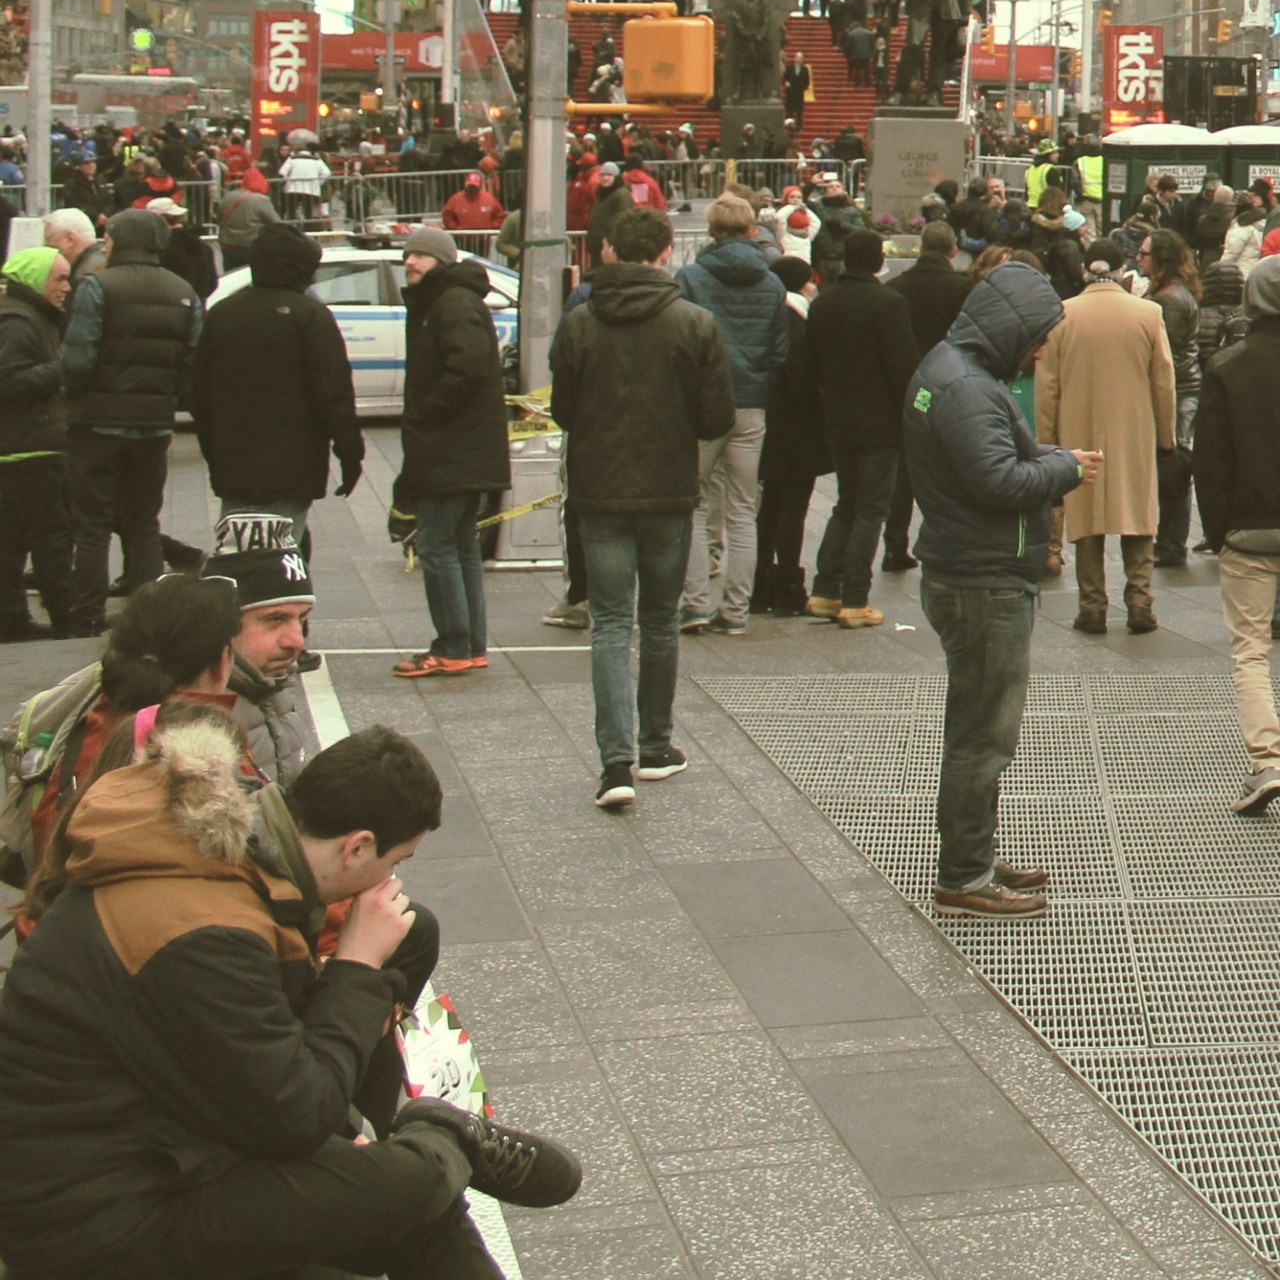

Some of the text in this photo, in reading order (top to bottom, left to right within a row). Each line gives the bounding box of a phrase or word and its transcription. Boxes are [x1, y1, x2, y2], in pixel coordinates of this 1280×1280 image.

[269, 19, 310, 94] tkts
[1118, 32, 1154, 103] tkts
[1182, 167, 1205, 176] FLUSH
[1259, 168, 1279, 176] ROYAL
